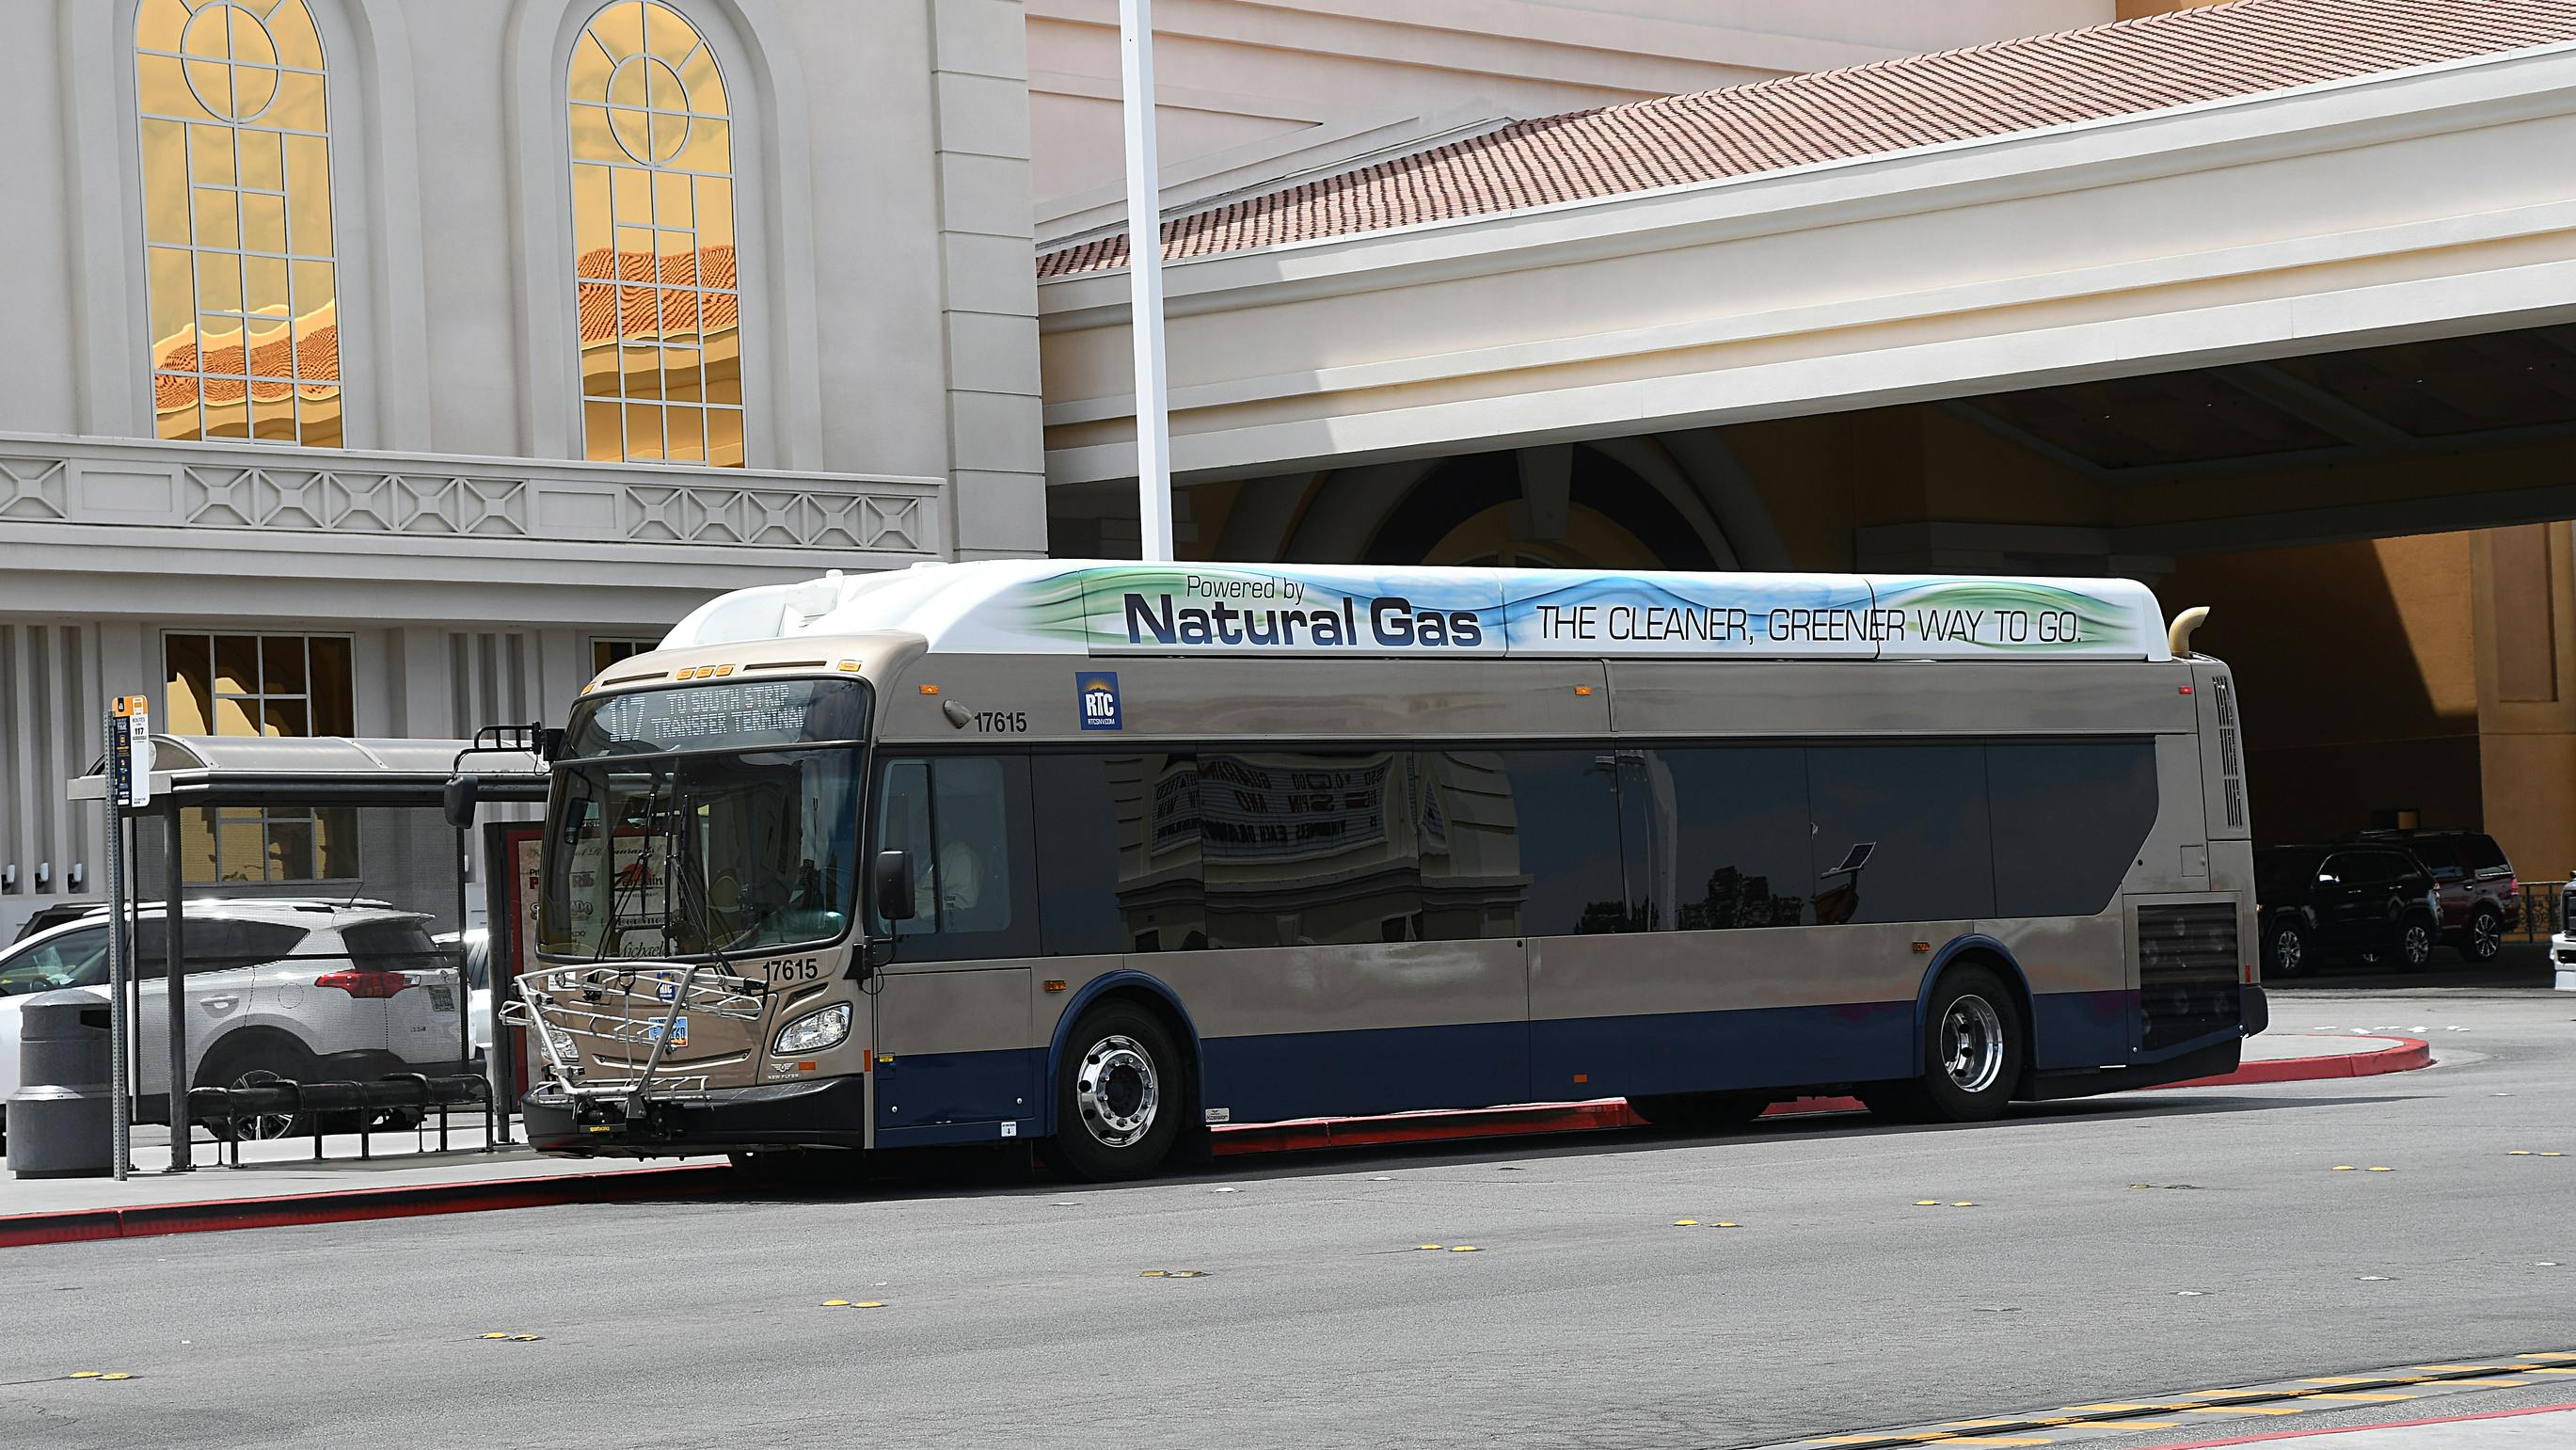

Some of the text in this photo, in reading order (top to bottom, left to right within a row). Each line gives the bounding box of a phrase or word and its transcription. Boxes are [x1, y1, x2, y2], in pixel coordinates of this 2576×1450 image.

[1187, 575, 1305, 605] Powered by
[1124, 593, 1483, 647] Natural Gas
[1536, 605, 2082, 645] THE CLEANER, GREENER WAY TO GO.
[666, 684, 790, 715] TO SOUTH STRIP
[1086, 693, 1115, 716] RTC
[609, 696, 646, 742] 117
[650, 706, 804, 739] TRANSFER TERMINAL
[974, 712, 1027, 732] 17615
[763, 958, 819, 981] 17615
